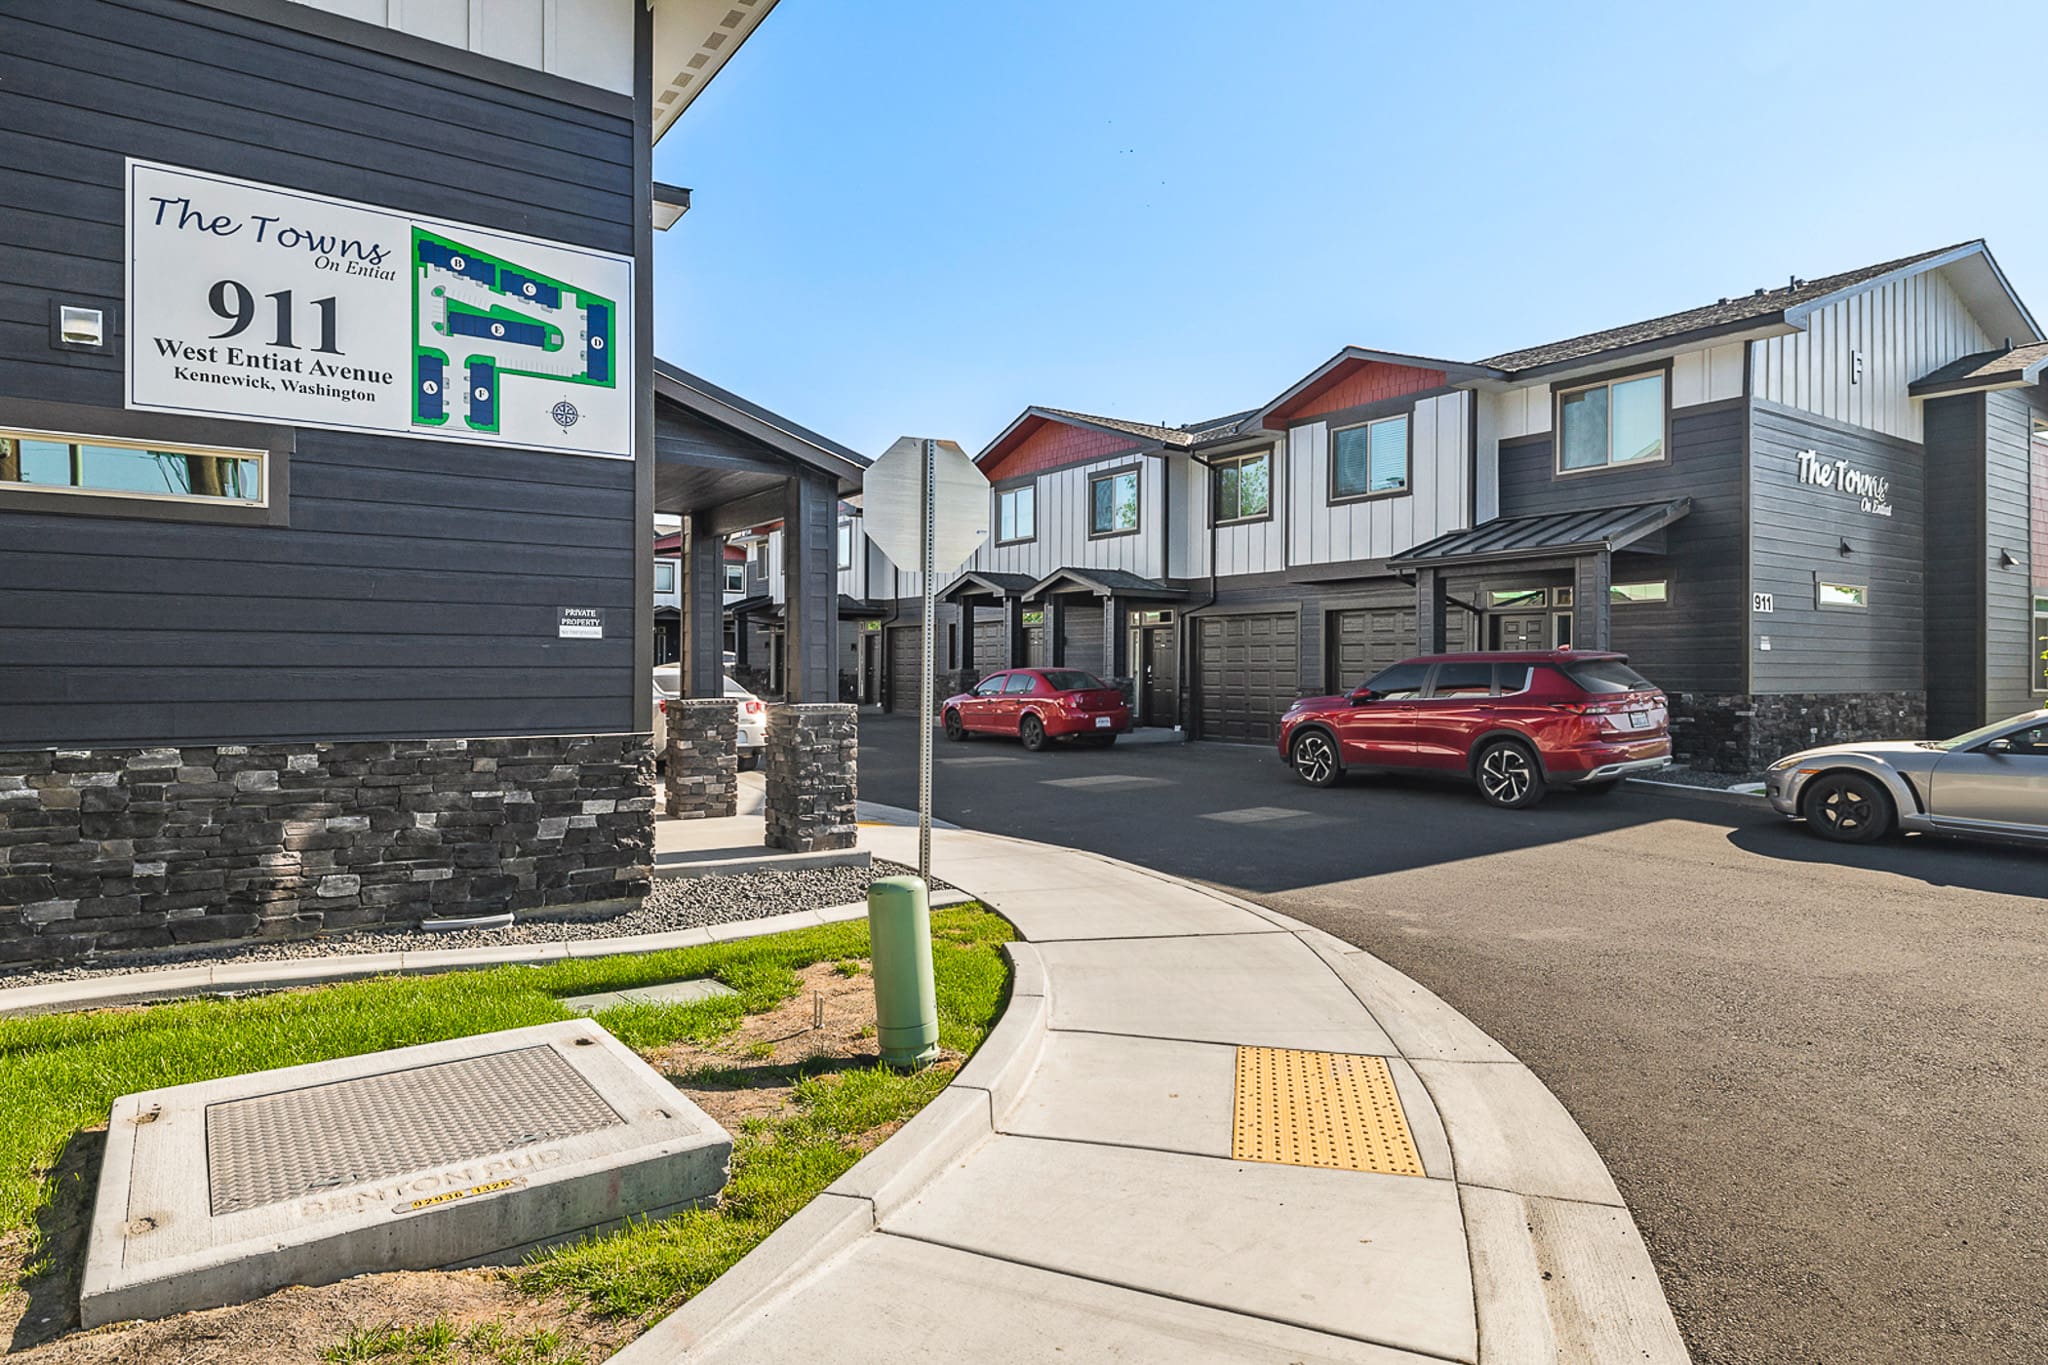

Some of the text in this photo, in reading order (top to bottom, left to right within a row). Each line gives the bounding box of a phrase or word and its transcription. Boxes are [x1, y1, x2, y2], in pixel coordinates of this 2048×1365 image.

[149, 197, 391, 265] The Towns
[314, 255, 397, 281] On Entiat
[208, 279, 345, 356] 911
[153, 337, 393, 385] West Entiat Avenue
[173, 366, 377, 403] Kennewick, Washington
[1797, 449, 1836, 488] The
[565, 608, 596, 617] PRIVATE
[1754, 594, 1771, 611] 911
[561, 618, 600, 626] PROPERTY
